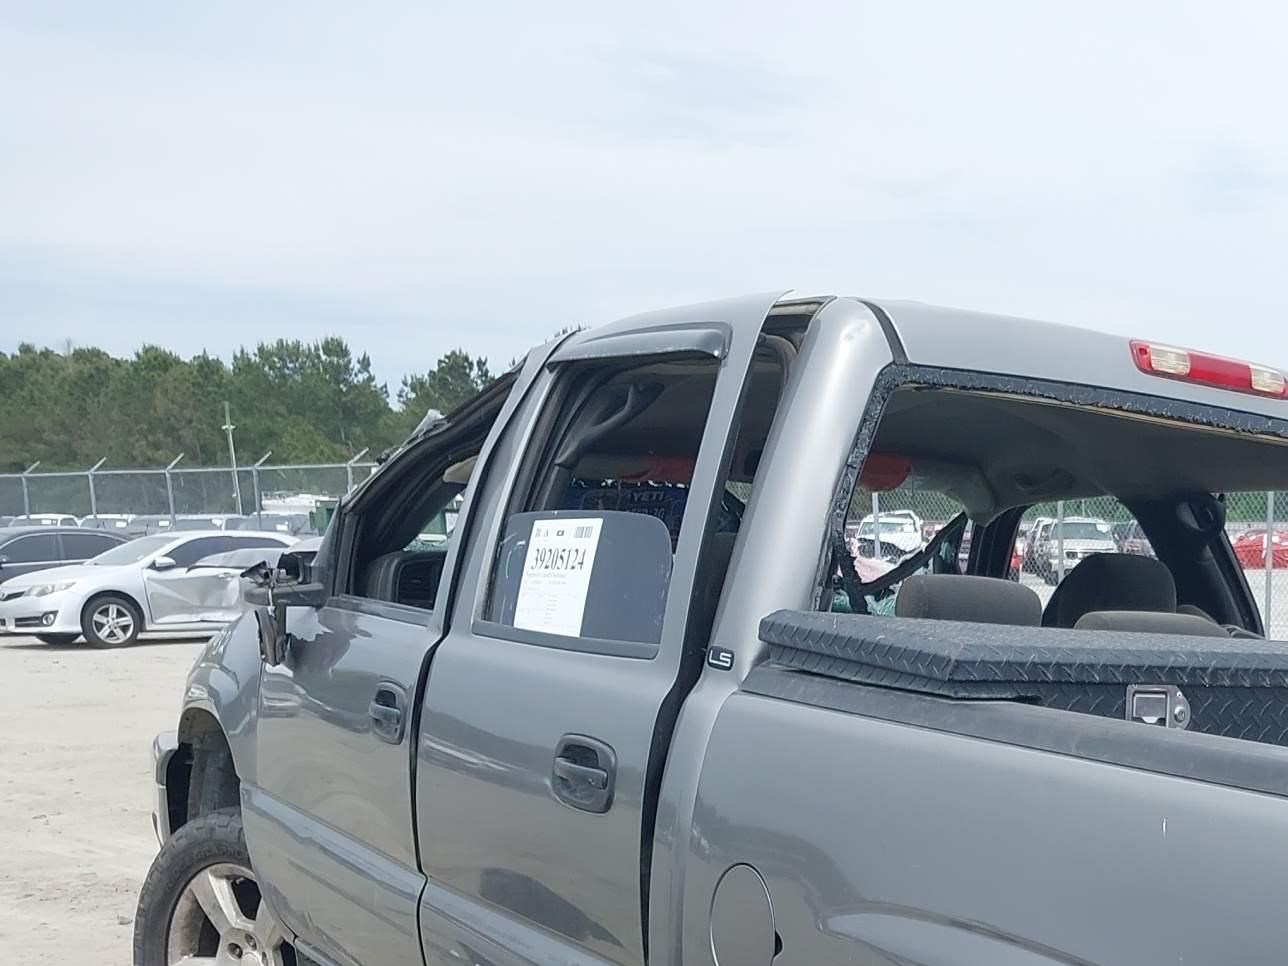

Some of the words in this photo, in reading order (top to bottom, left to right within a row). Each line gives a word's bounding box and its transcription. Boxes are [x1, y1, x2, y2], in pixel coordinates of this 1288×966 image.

[632, 490, 665, 502] YETI
[530, 547, 587, 570] 39205124
[709, 649, 732, 667] LS
